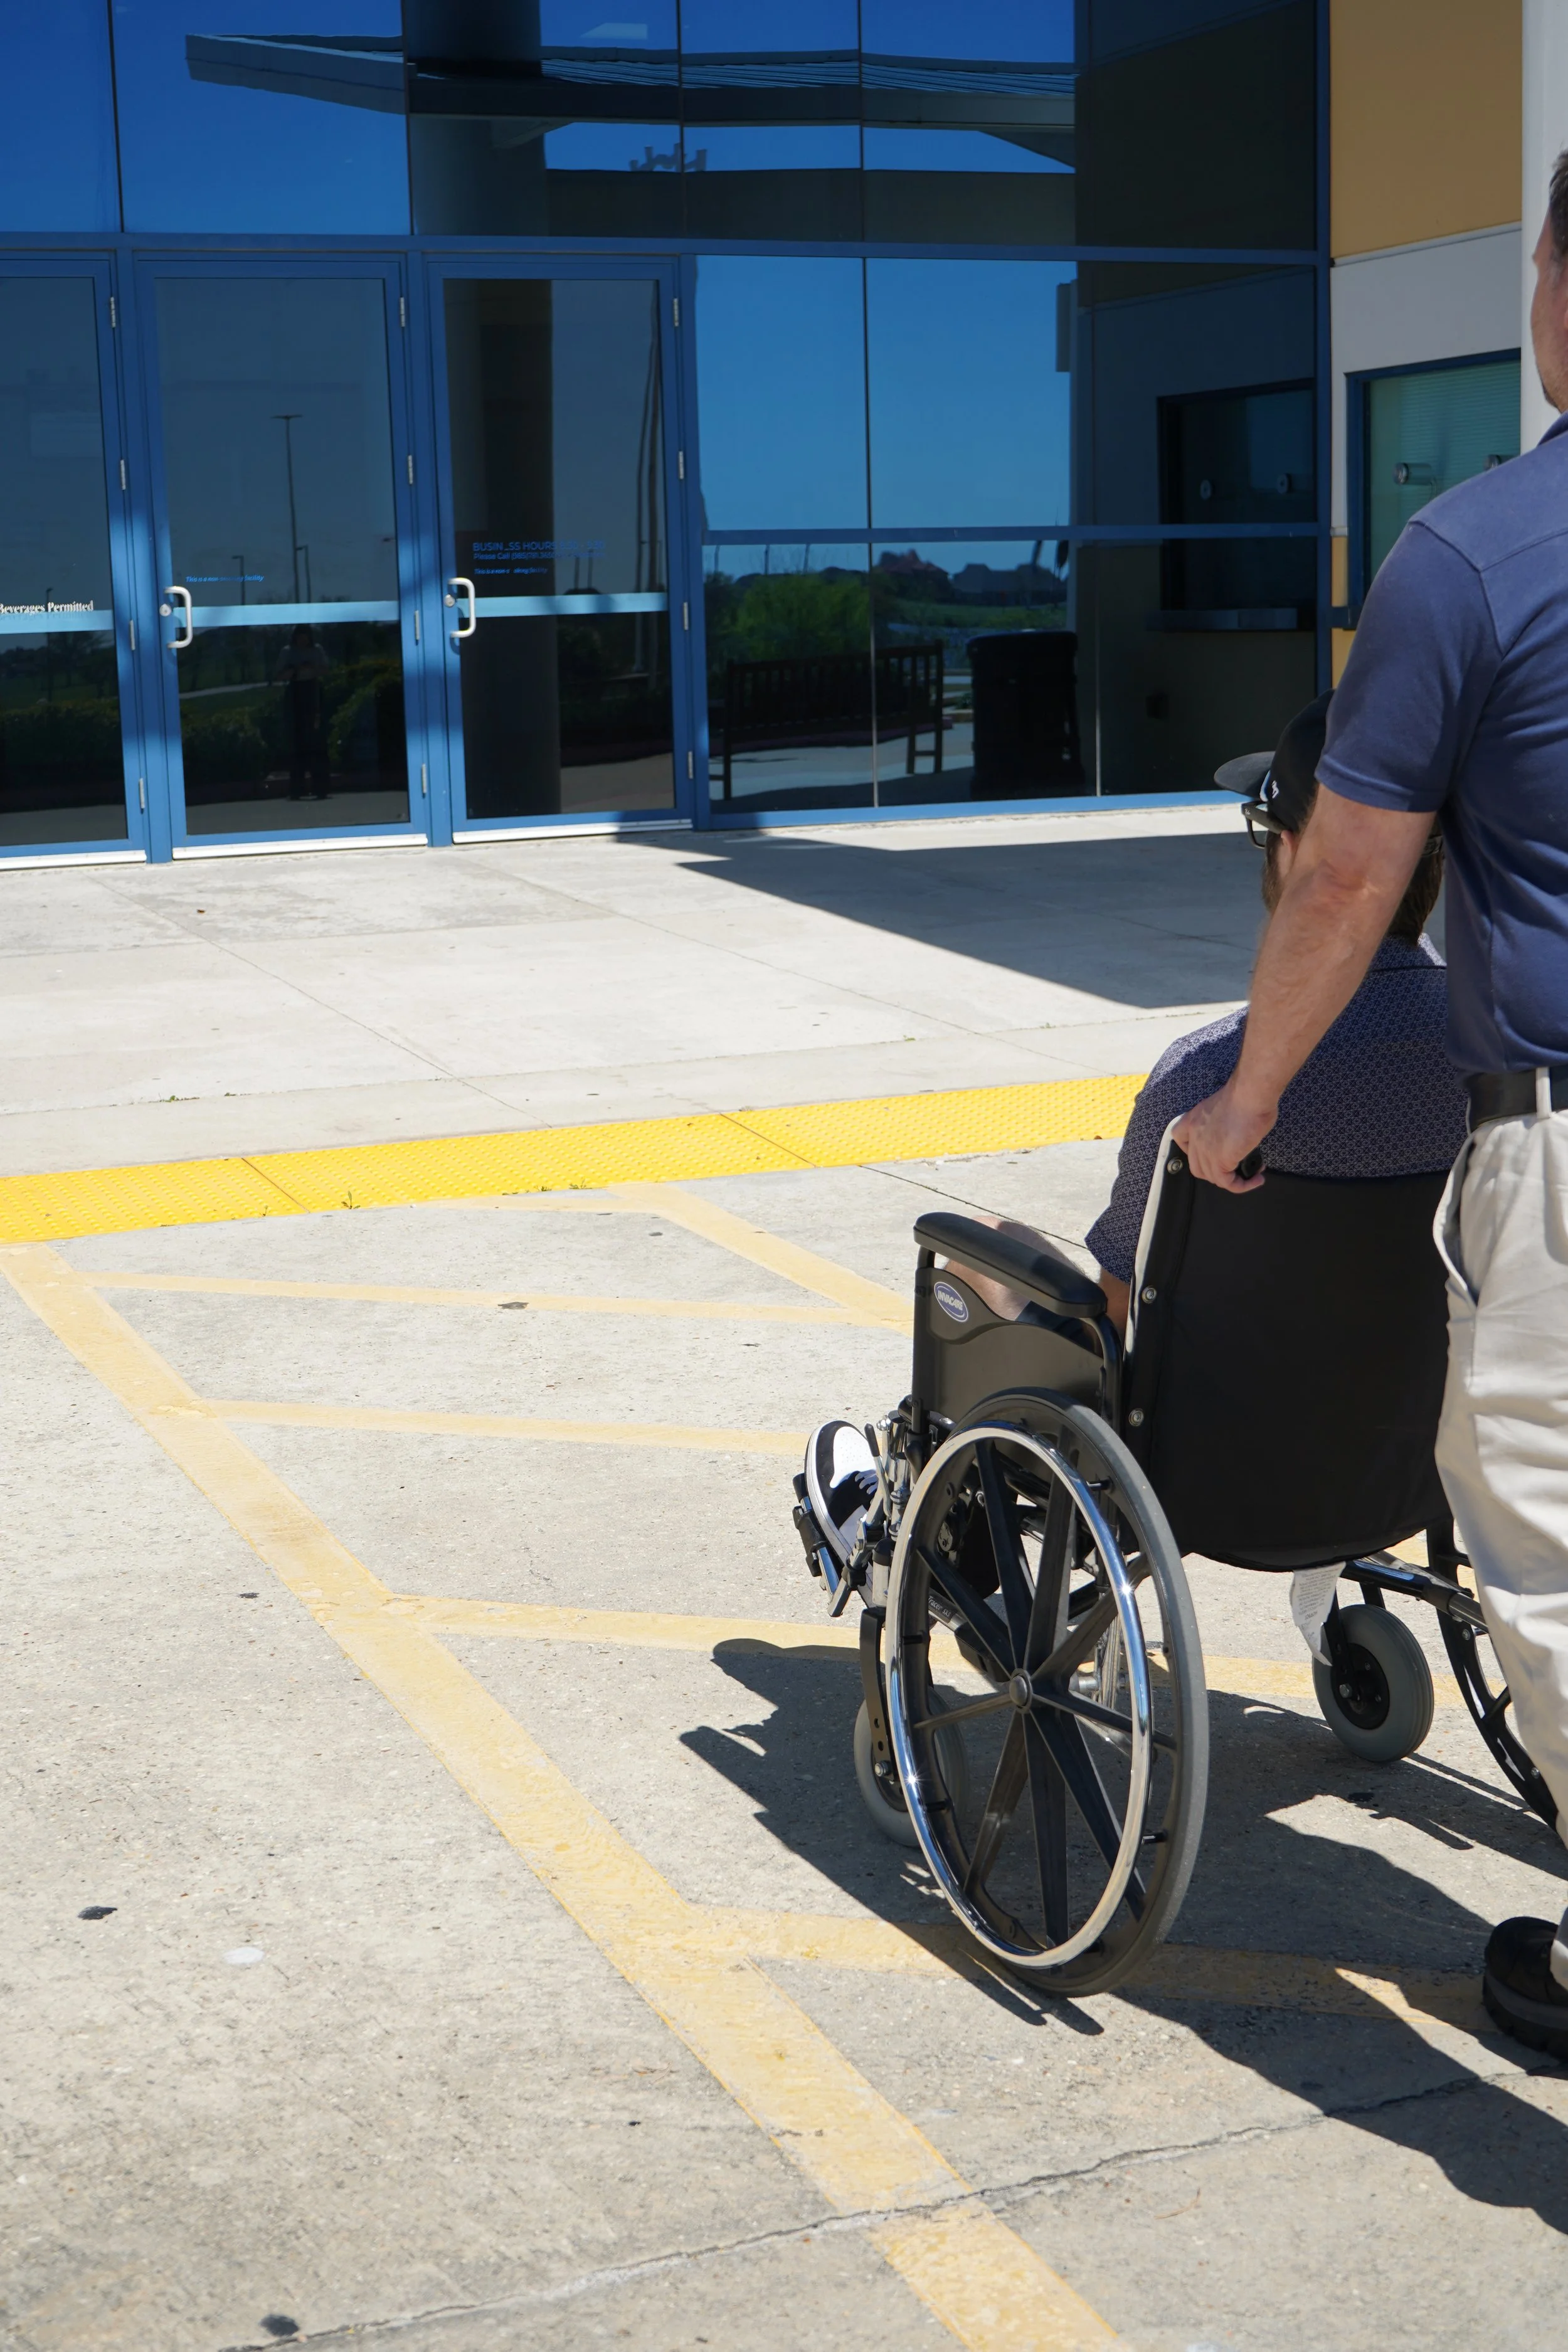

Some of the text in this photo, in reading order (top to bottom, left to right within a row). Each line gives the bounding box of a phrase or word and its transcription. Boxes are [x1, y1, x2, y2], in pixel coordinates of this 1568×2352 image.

[522, 541, 556, 550] HOURS
[0, 600, 93, 615] Beverages Permitted
[938, 1290, 963, 1311] INVACARE
[928, 1595, 943, 1611] Tracer
